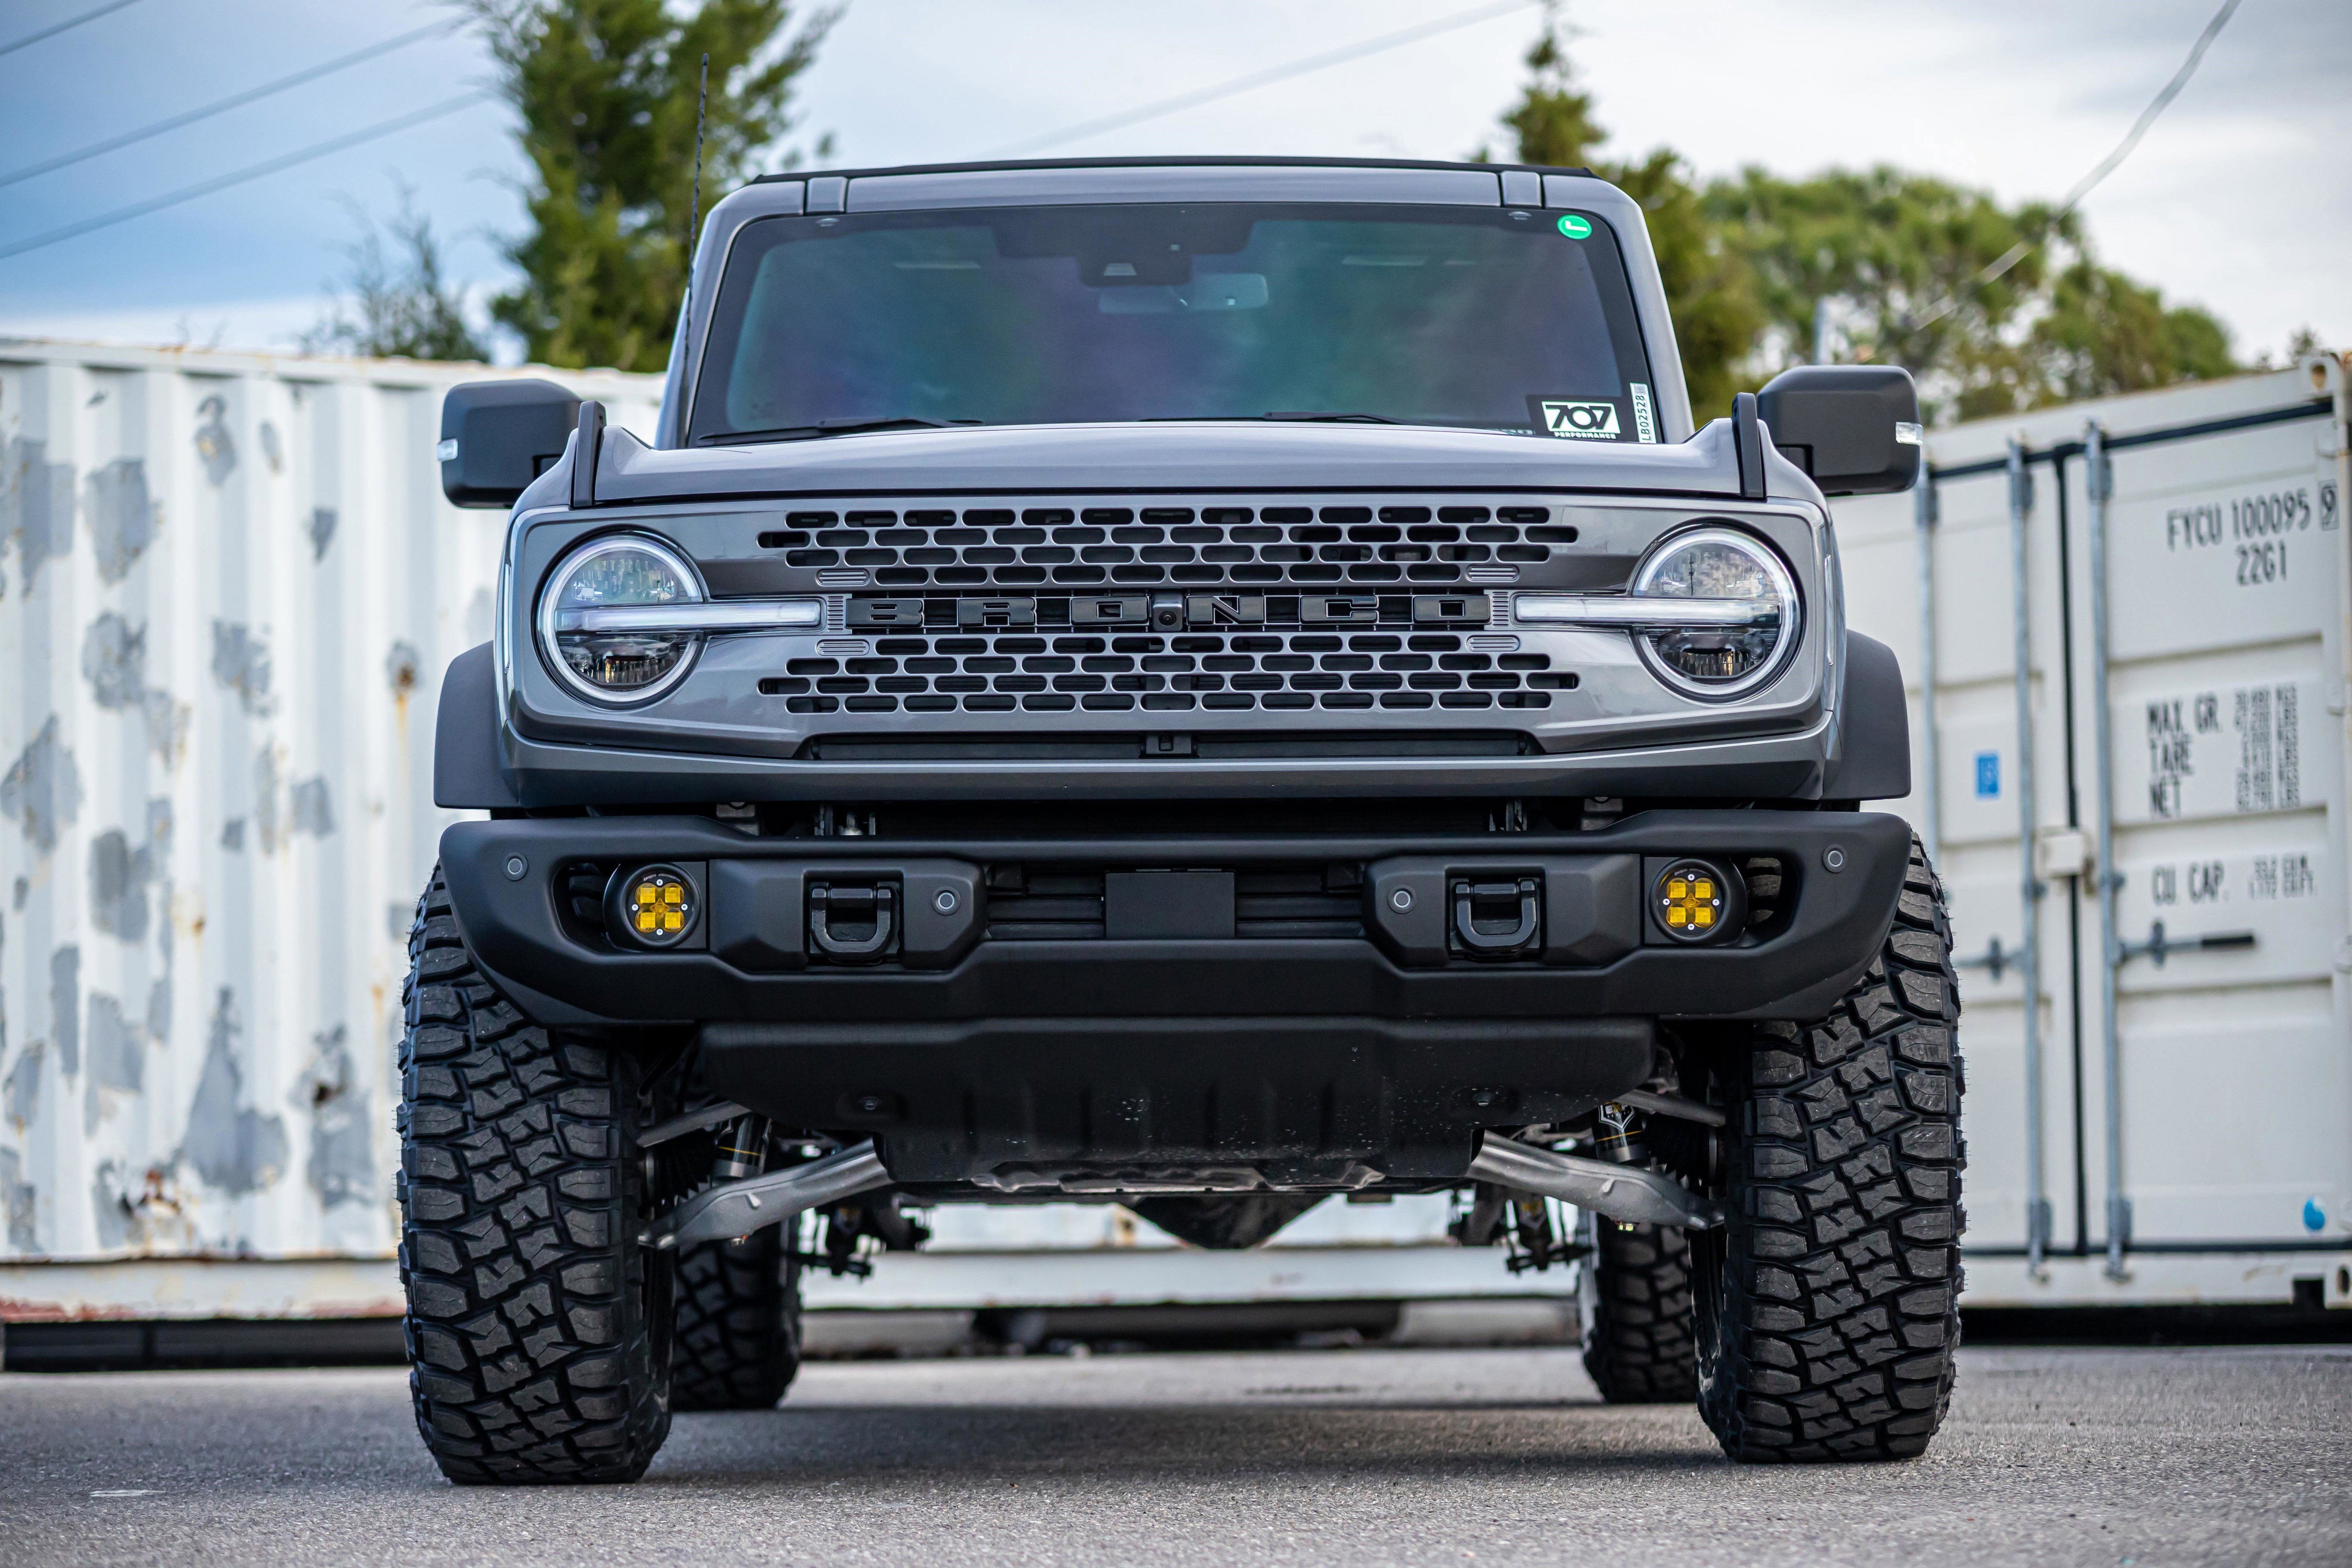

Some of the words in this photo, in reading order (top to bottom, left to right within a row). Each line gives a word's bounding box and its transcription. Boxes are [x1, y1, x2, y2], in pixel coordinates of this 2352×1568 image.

[1546, 404, 1612, 430] 707
[1635, 395, 1651, 443] LB02528
[2167, 502, 2223, 552] FYCU
[2231, 488, 2312, 541] 100095
[2235, 539, 2287, 586] 22G1
[844, 595, 1491, 629] BRONCO
